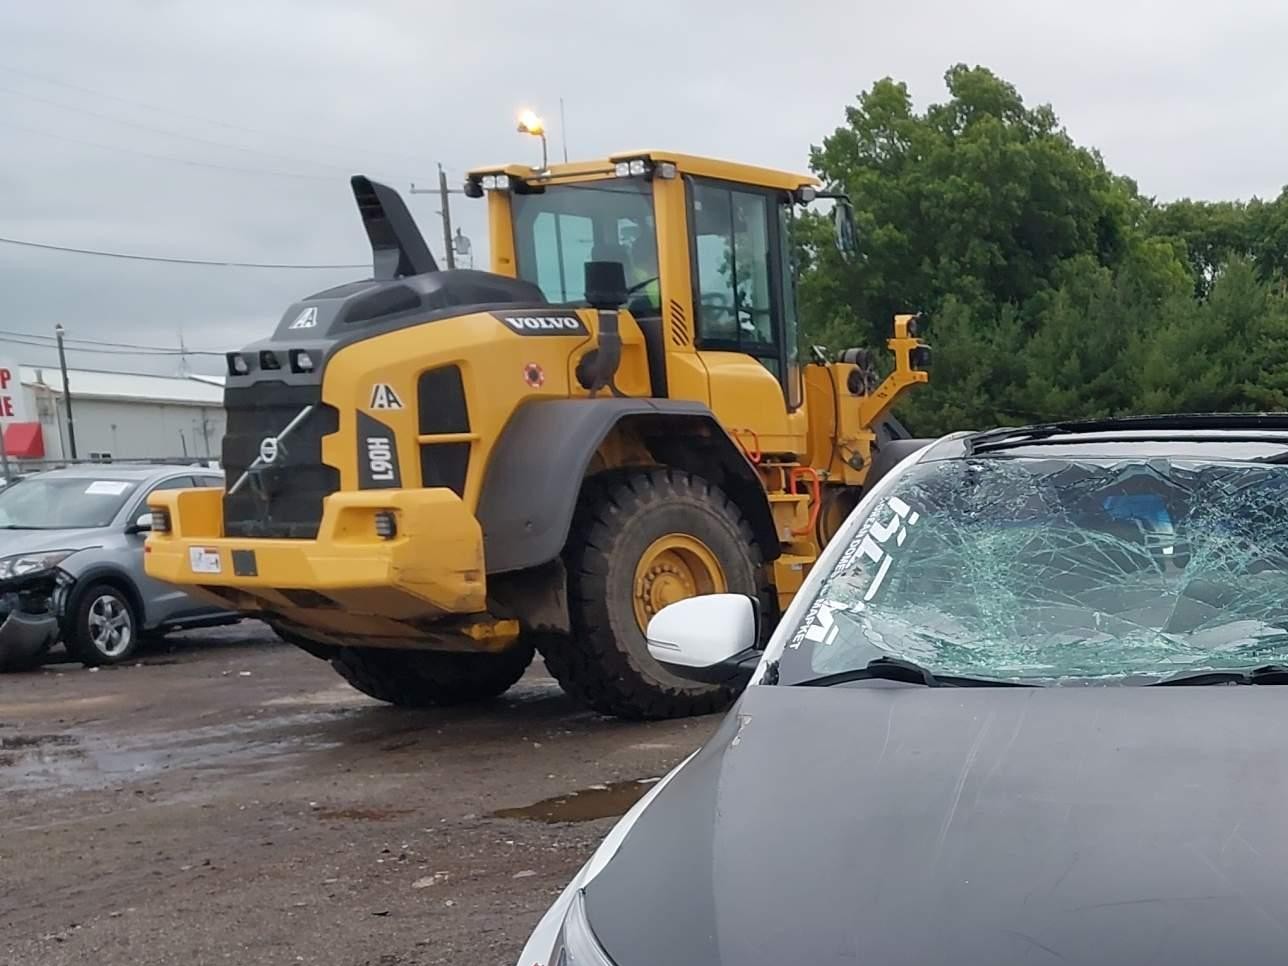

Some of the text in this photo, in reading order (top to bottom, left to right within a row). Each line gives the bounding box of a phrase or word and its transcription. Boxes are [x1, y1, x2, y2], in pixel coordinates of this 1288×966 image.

[505, 317, 579, 329] VOLVO
[366, 437, 394, 480] L90H
[790, 599, 824, 650] MARKET
